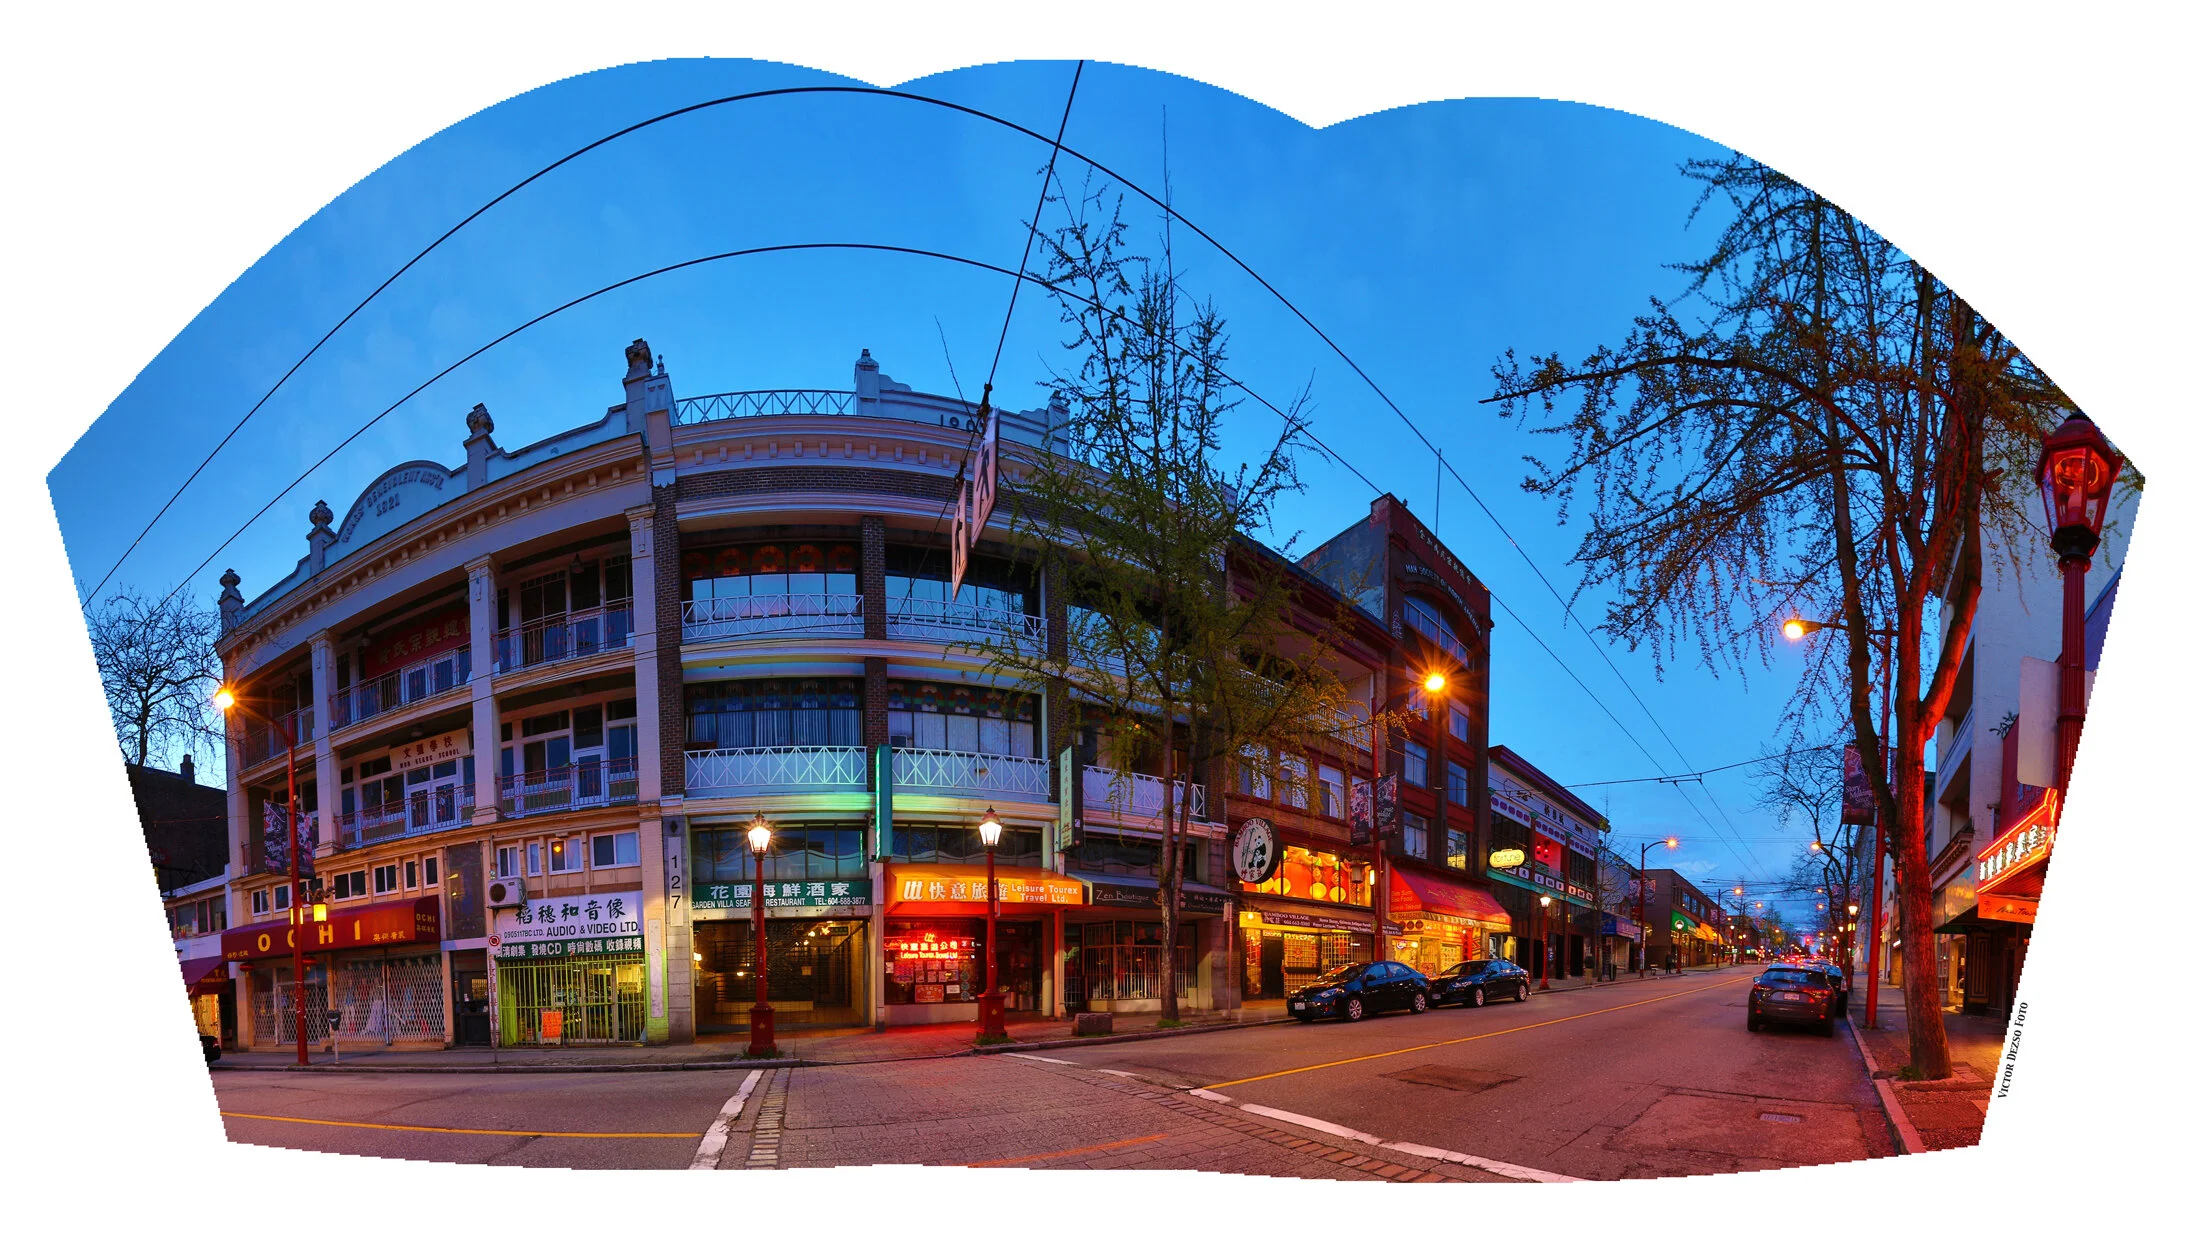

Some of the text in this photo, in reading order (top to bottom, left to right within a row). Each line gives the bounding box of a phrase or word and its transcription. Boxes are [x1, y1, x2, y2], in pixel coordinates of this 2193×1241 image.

[940, 414, 983, 435] 190
[1418, 566, 1440, 582] SOCIETY
[1447, 585, 1463, 606] NORTH
[1463, 606, 1481, 637] AMERICA
[438, 748, 460, 759] SCHOOL
[1233, 819, 1273, 848] BAMBOO VILLAGE
[1493, 854, 1521, 862] fortune
[670, 855, 682, 909] 127
[1011, 884, 1078, 894] Leisure Tourex
[710, 882, 850, 899] 花園海鮮酒家
[1095, 889, 1149, 903] Zen Boutique
[692, 900, 716, 909] GARDEN
[716, 899, 734, 909] VILLA
[735, 898, 752, 908] SEAF
[765, 898, 806, 907] RESTAURANT
[1020, 893, 1068, 903] Travel Ltd.
[415, 913, 436, 924] OCHI
[516, 898, 627, 925] 稻穗和音像
[1264, 911, 1289, 919] BAMBOO
[533, 928, 544, 938] LTD.
[546, 920, 641, 937] AUDIO & VIDEO LTD.
[496, 944, 526, 958] 清劇集
[567, 939, 603, 954] 時尚數碼
